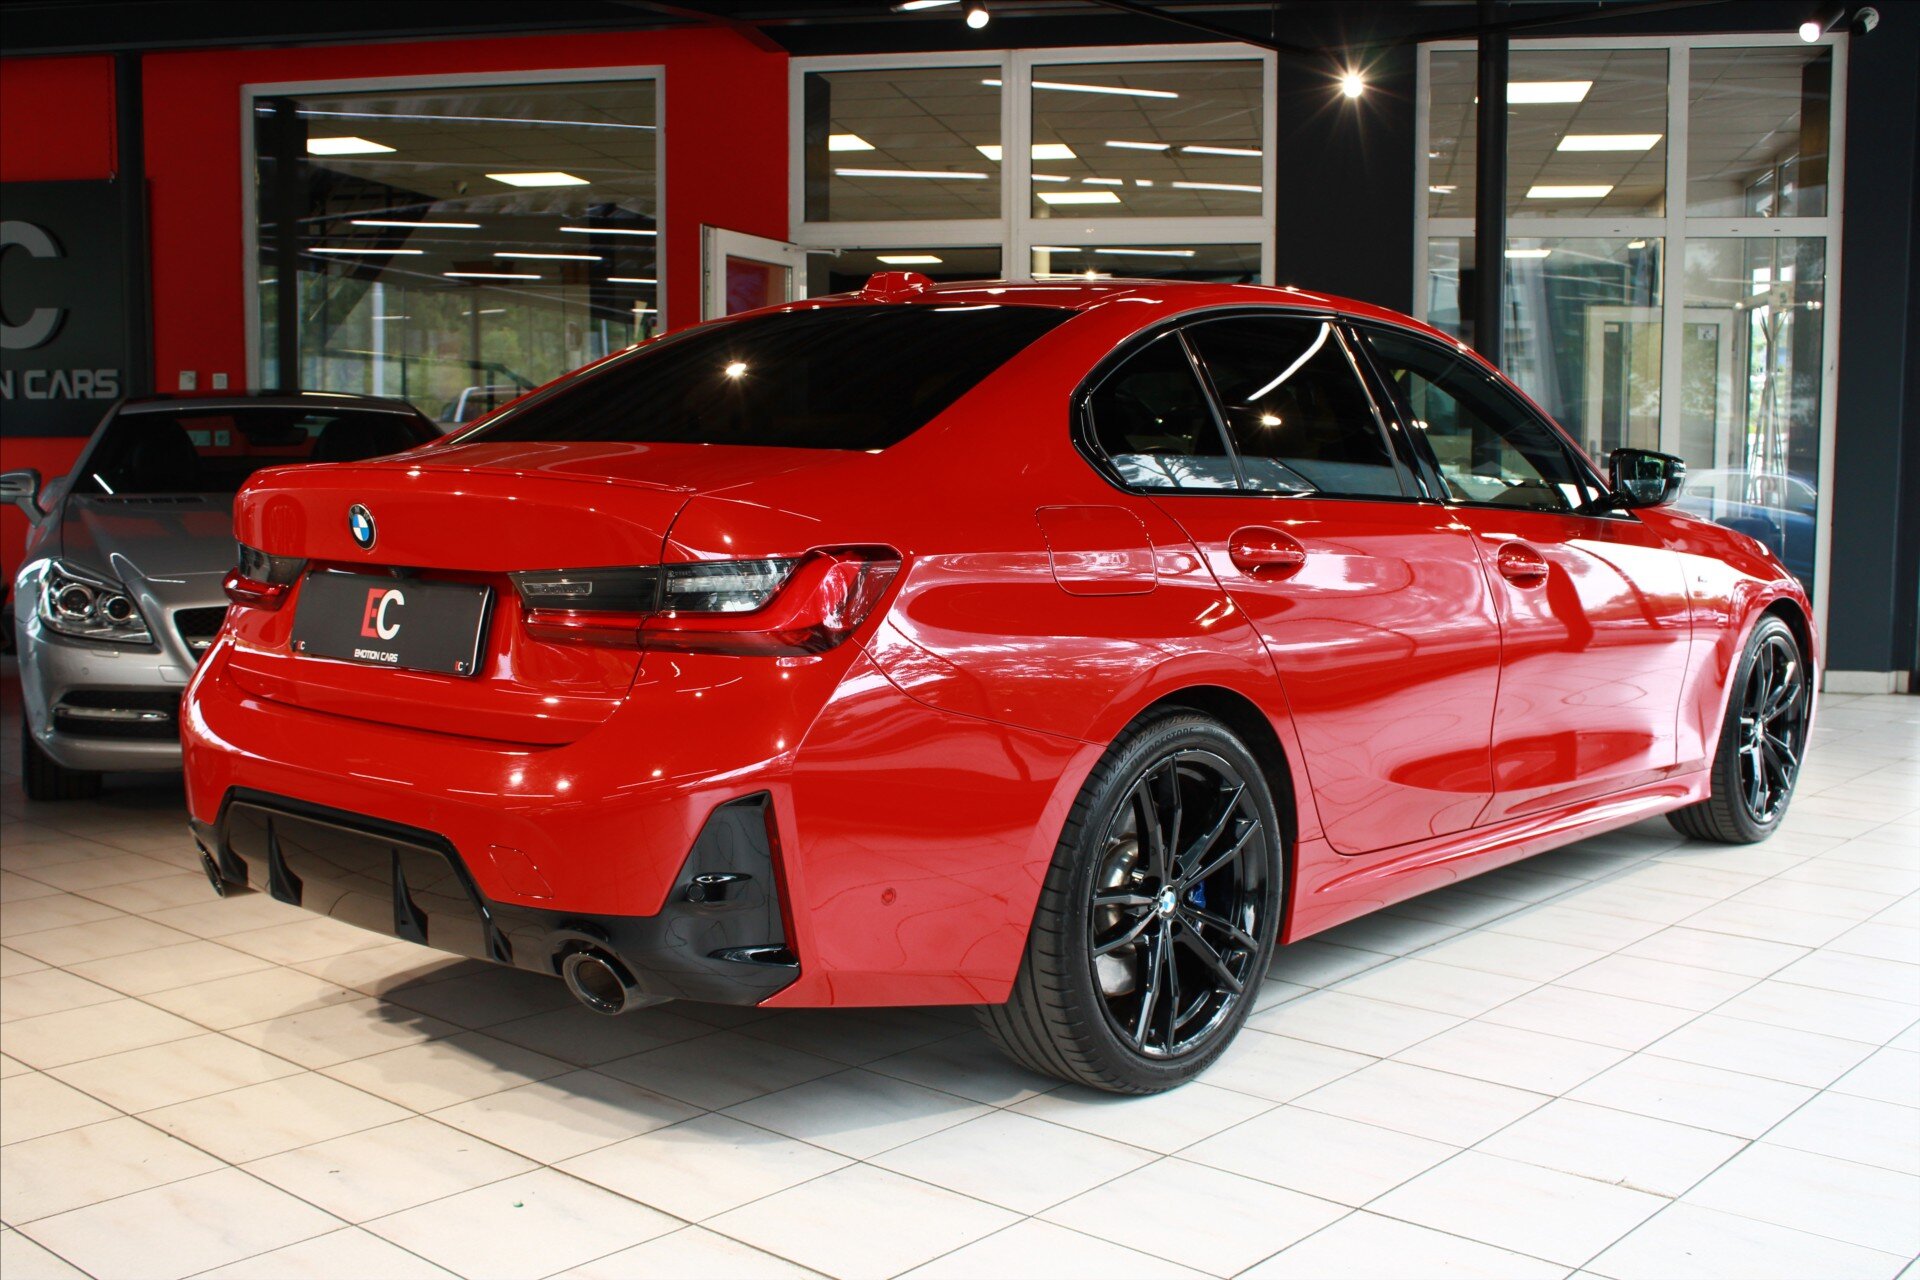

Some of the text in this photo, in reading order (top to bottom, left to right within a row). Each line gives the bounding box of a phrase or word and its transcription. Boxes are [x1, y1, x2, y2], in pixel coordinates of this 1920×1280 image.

[24, 369, 119, 399] CARS
[361, 588, 405, 640] EC
[354, 648, 399, 662] EMOTION CARS
